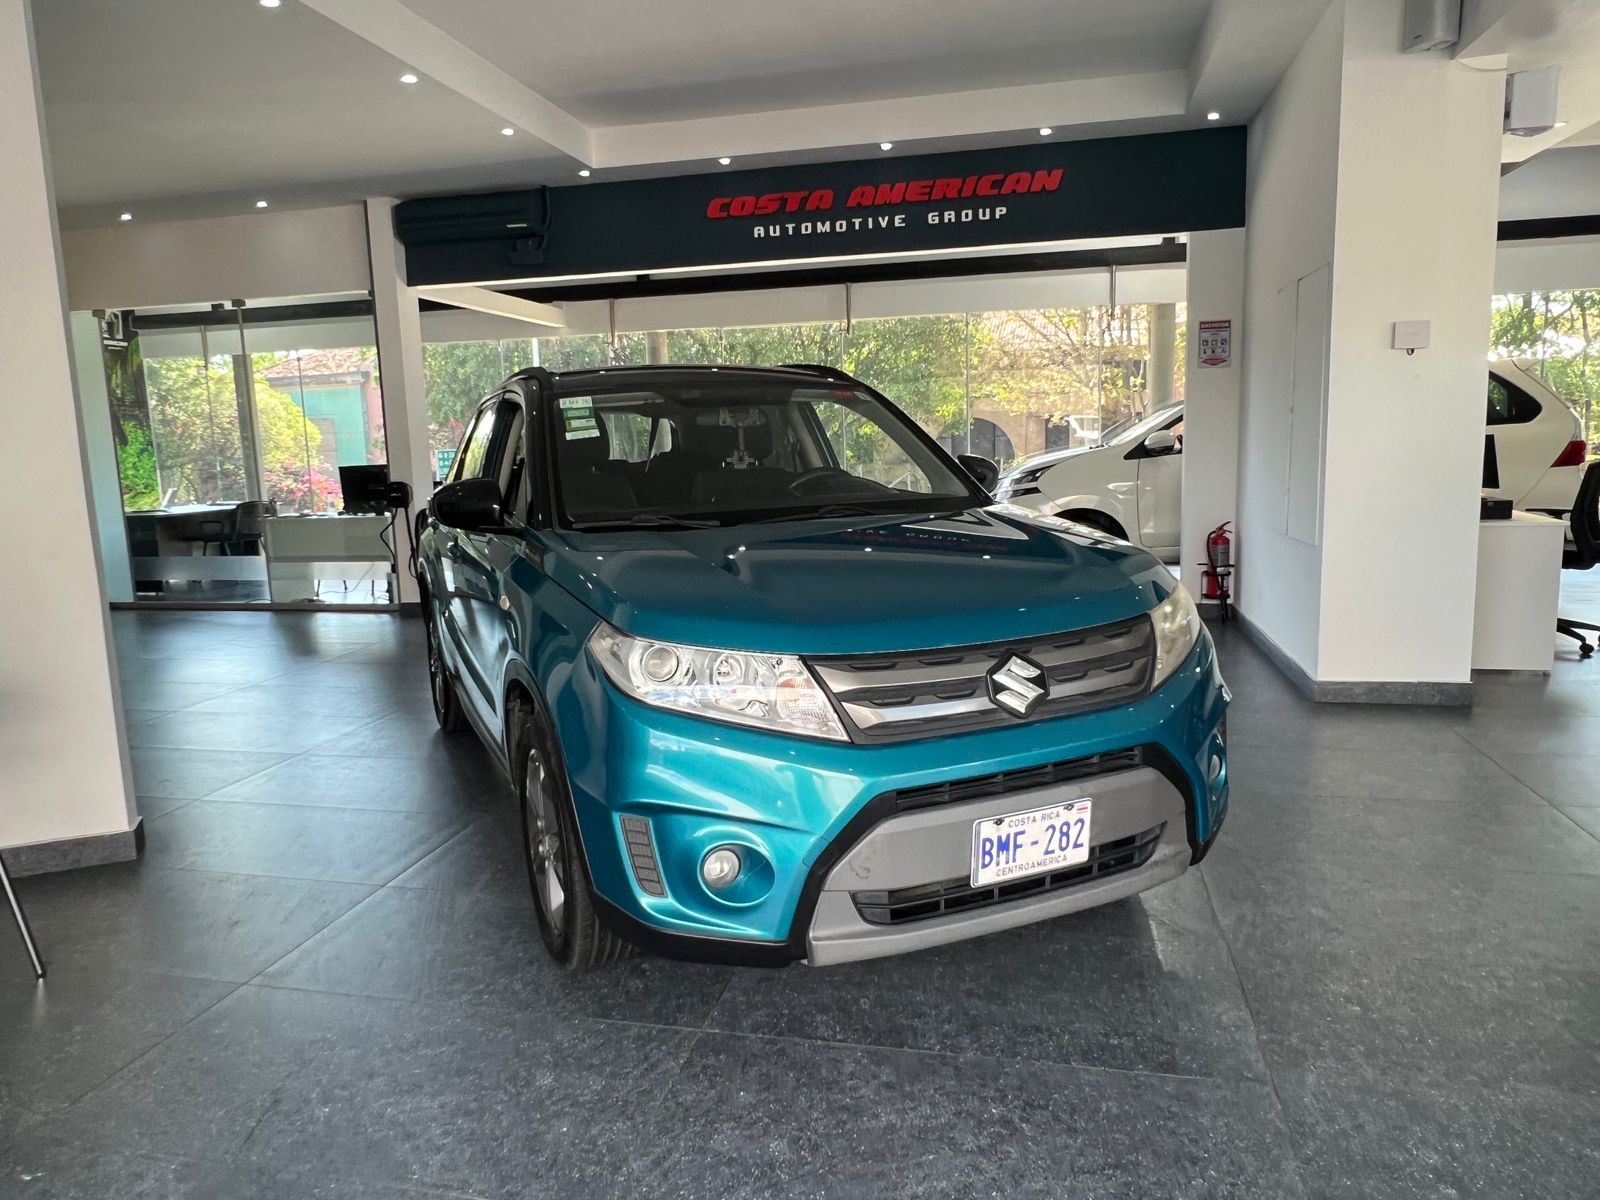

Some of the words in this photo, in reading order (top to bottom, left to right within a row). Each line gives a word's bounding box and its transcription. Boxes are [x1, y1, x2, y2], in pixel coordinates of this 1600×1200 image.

[706, 188, 835, 218] COSTA
[846, 168, 1064, 208] AMERICAN
[753, 215, 906, 239] AUTOMOTIVE
[927, 206, 1007, 225] GROUP
[1008, 815, 1036, 828] COSTA
[1041, 810, 1060, 821] RICA
[980, 817, 1085, 870] BMF-282
[996, 854, 1068, 877] CENTROAMERICA
